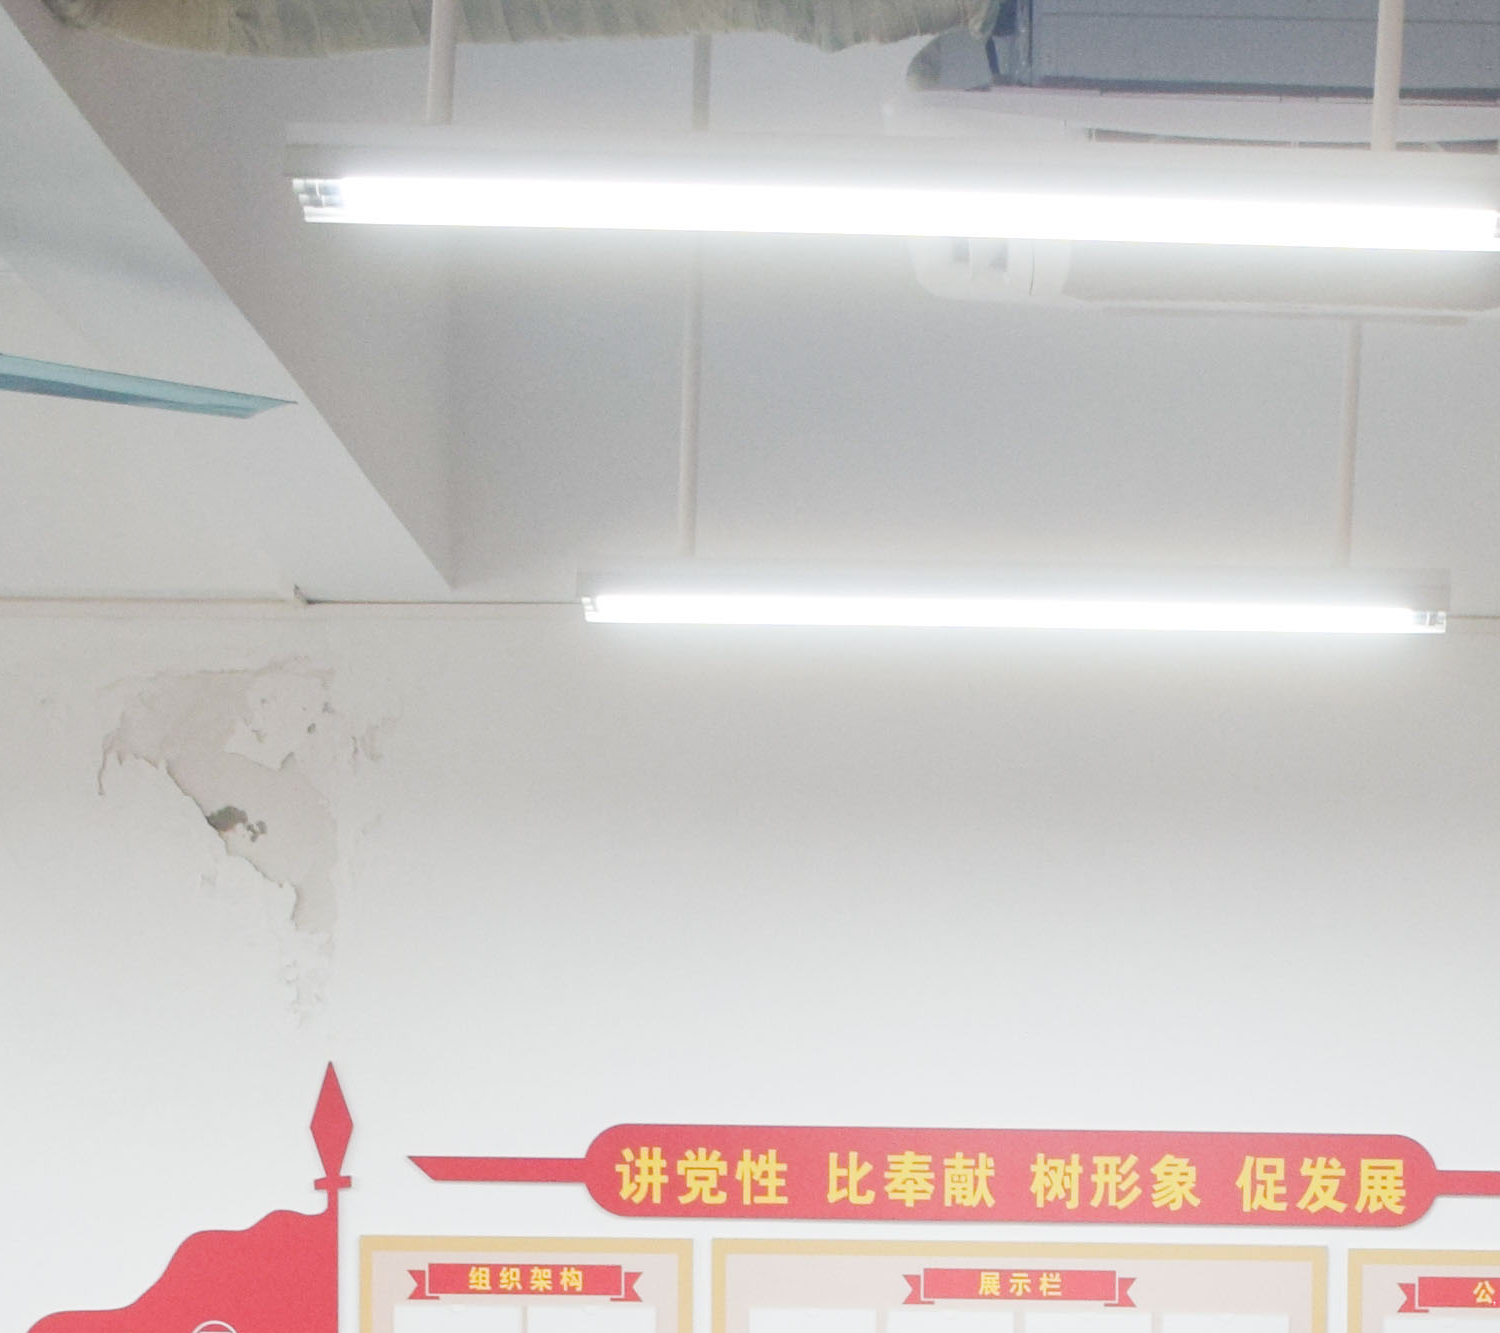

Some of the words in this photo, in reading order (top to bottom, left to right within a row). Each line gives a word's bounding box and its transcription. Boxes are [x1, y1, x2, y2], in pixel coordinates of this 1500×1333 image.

[615, 1147, 788, 1206] 讲党性
[827, 1150, 996, 1208] 比奉献
[1030, 1152, 1200, 1211] 树形象
[1235, 1156, 1406, 1214] 促发展
[468, 1267, 584, 1292] 组织架构
[978, 1271, 1062, 1297] 展示栏
